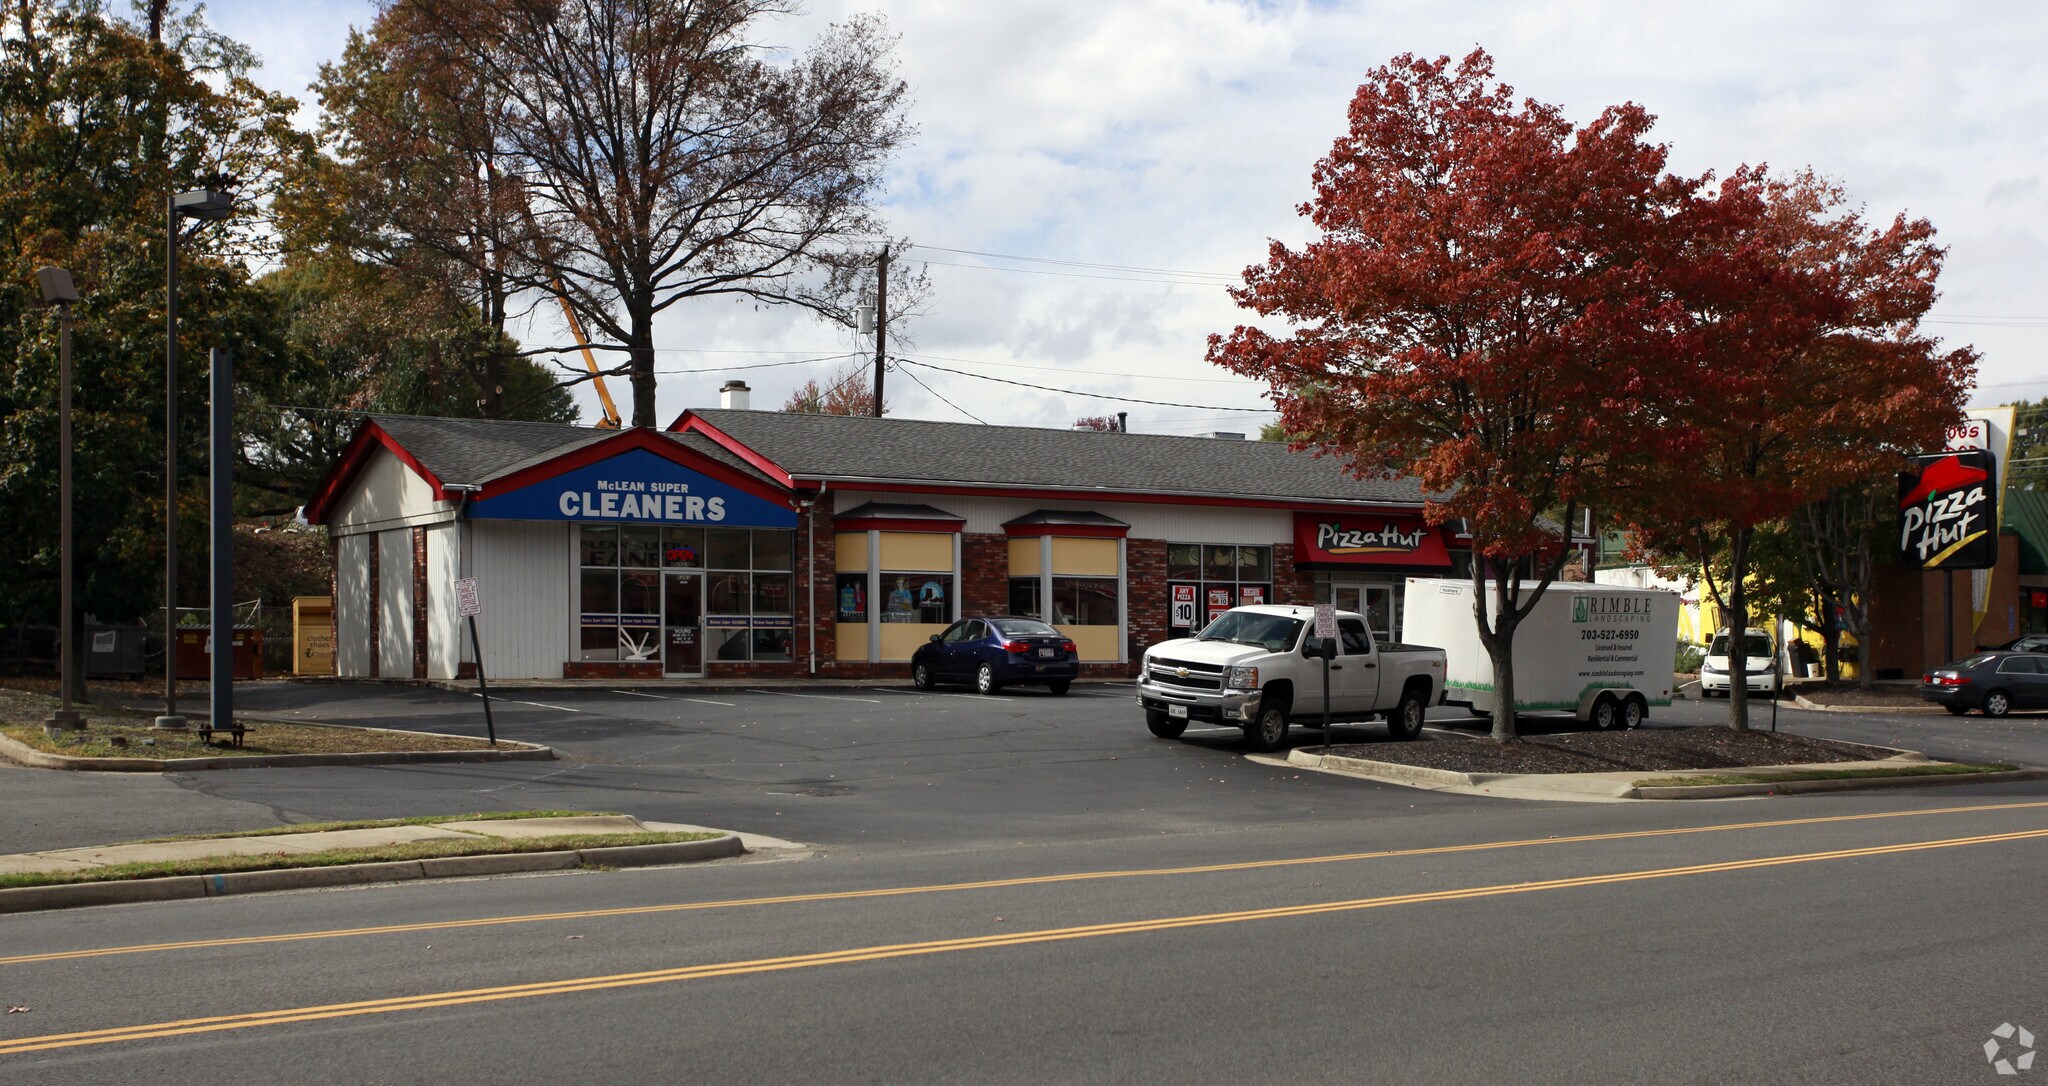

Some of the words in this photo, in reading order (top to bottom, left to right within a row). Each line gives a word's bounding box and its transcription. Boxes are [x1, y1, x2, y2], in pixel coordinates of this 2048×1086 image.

[597, 480, 645, 491] McLEAN
[650, 482, 689, 493] SUPER
[559, 491, 726, 521] CLEANERS
[1901, 486, 1987, 551] Pizza
[1317, 523, 1378, 549] Pizza
[1379, 523, 1429, 548] Hut
[1916, 511, 1979, 560] Hut
[665, 549, 695, 561] OPEN
[1177, 593, 1192, 601] PIZZA
[1176, 604, 1192, 620] $10
[1590, 597, 1652, 613] RIMBLE
[1581, 629, 1640, 640] 703-527-6950
[1618, 643, 1633, 651] Insured
[1615, 654, 1638, 662] Commercial
